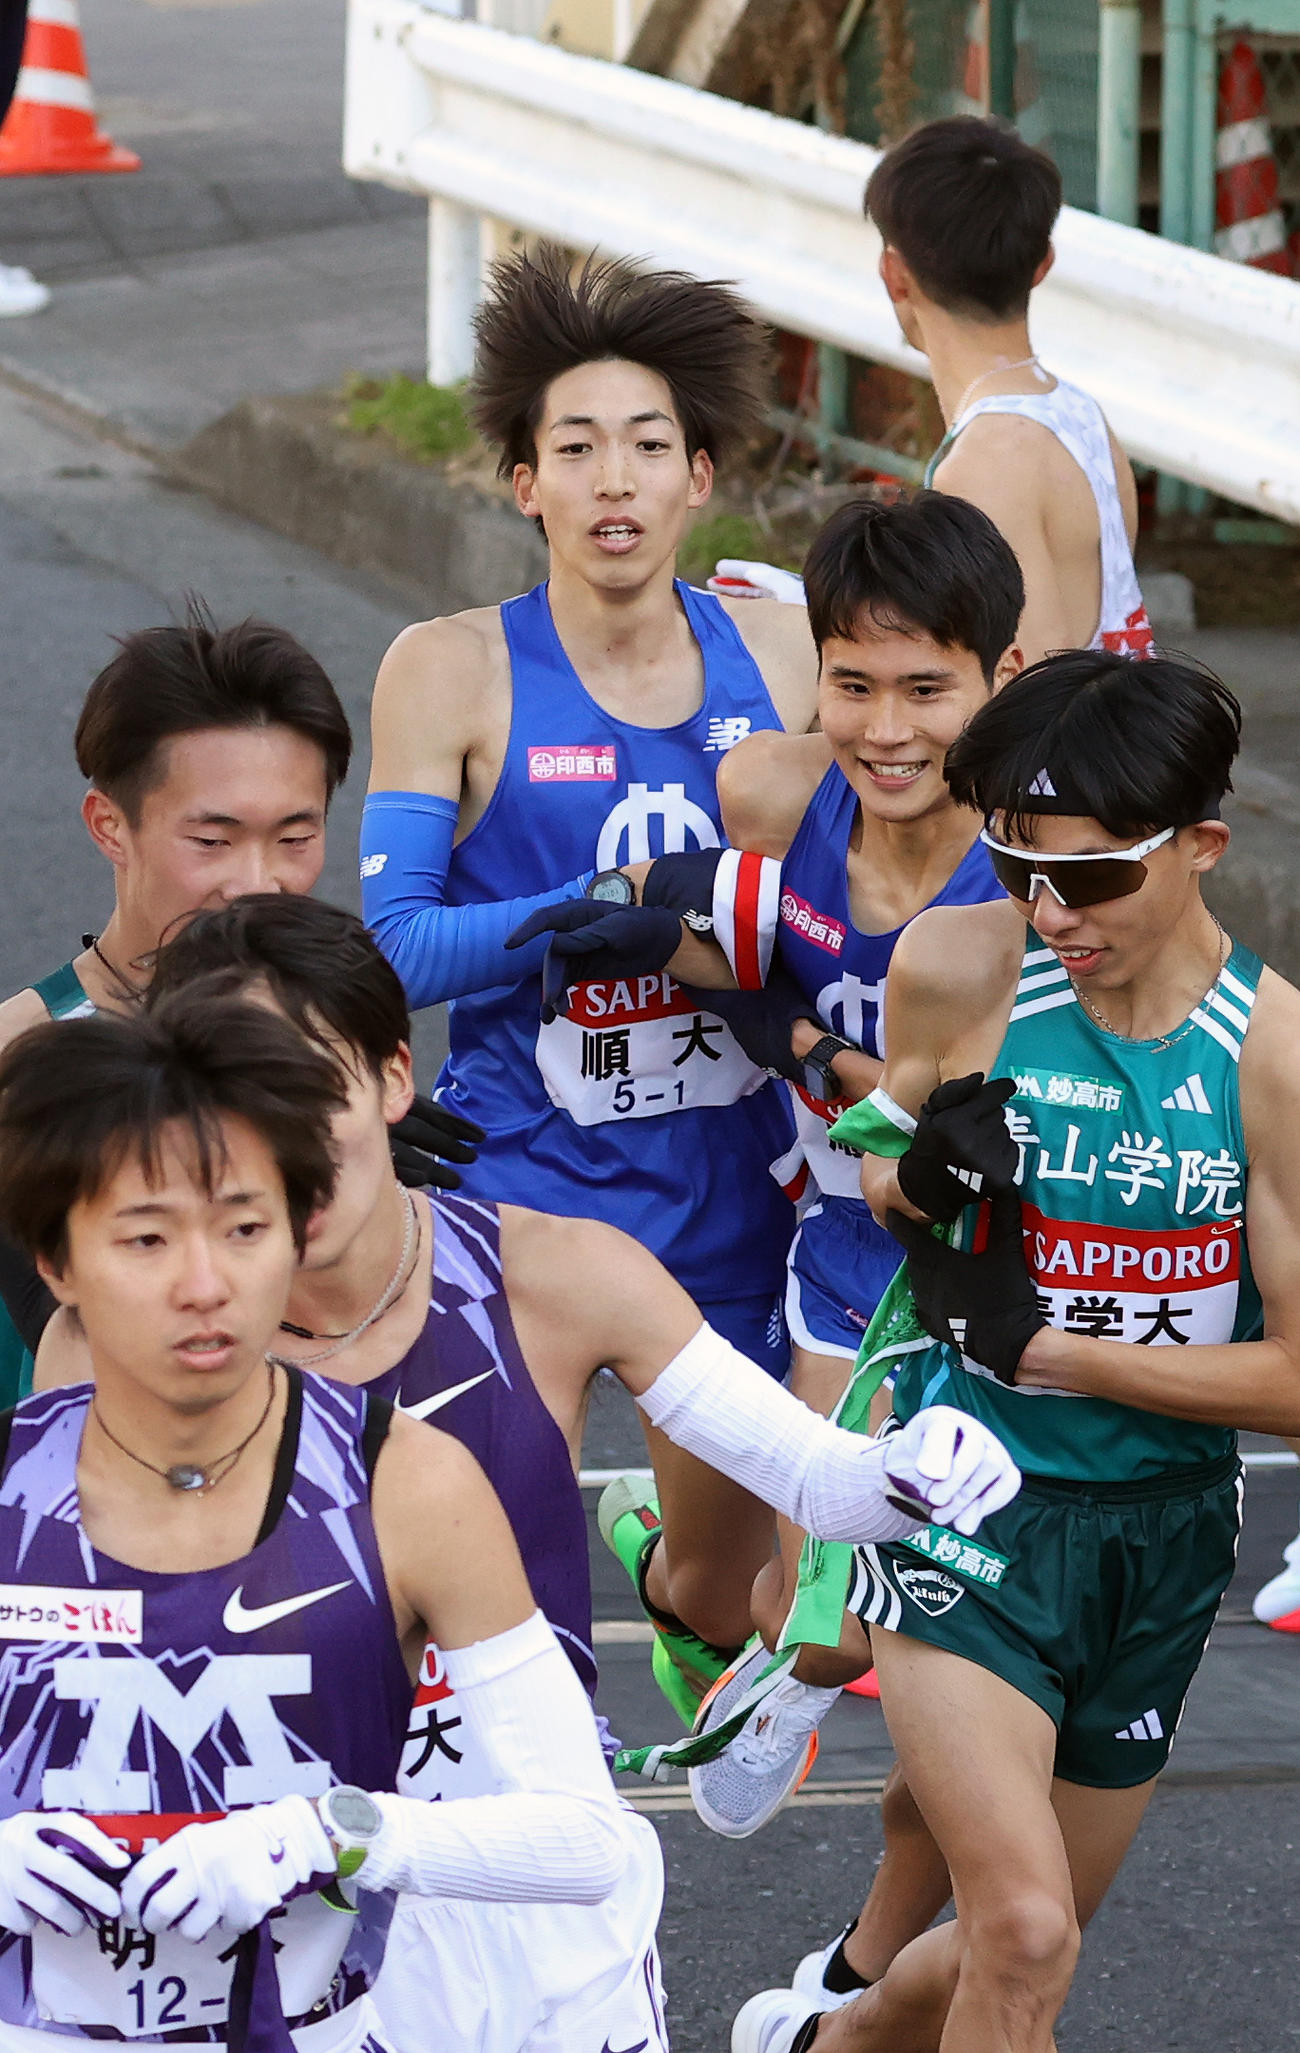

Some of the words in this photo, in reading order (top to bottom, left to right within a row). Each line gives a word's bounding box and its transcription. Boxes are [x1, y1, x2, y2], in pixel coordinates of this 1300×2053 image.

[556, 755, 615, 775] 印西市
[793, 909, 844, 950] 印西市
[585, 973, 680, 1017] SAPP
[581, 1015, 723, 1081] 順大
[613, 1079, 685, 1113] 5-1
[1047, 1075, 1123, 1112] 妙高市
[1033, 1231, 1230, 1282] SAPPORO
[931, 1533, 1006, 1583] 妙高市
[42, 1654, 331, 1812] M
[402, 1709, 463, 1779] 大
[127, 1976, 225, 2029] 12-
